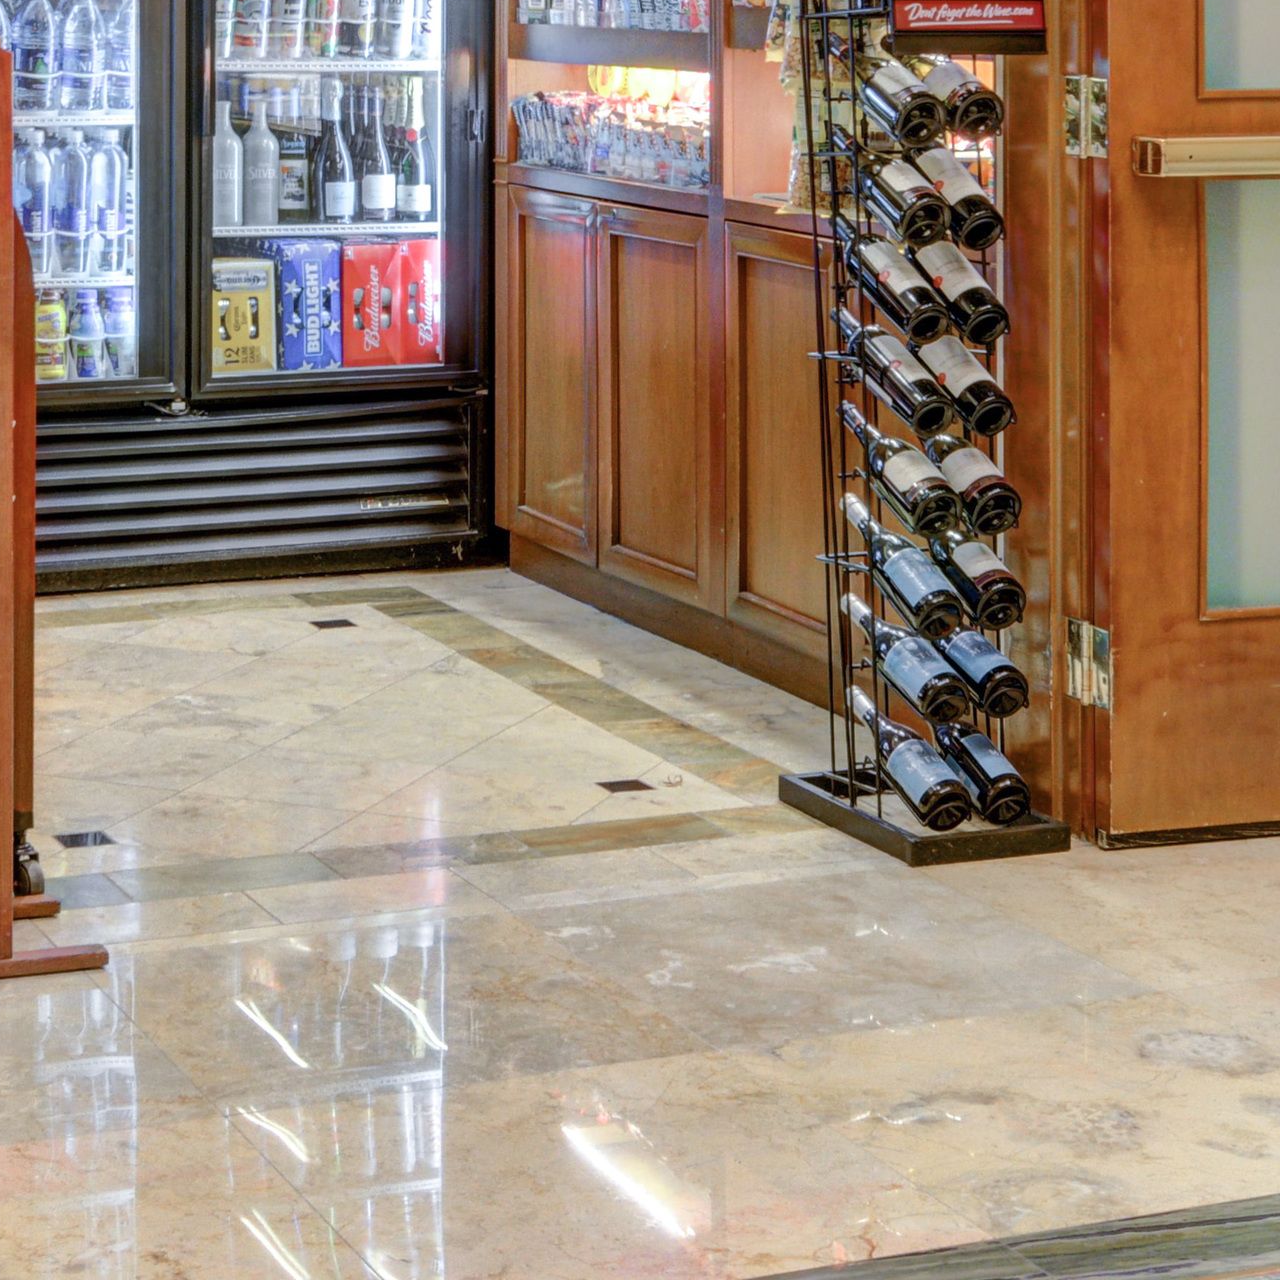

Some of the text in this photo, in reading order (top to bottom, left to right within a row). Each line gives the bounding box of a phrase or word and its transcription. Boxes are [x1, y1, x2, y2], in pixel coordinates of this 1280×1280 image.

[935, 3, 965, 21] forget
[966, 4, 982, 18] the
[305, 262, 321, 353] BUD LIGHT
[364, 264, 380, 351] Budweiser
[224, 347, 240, 366] 12
